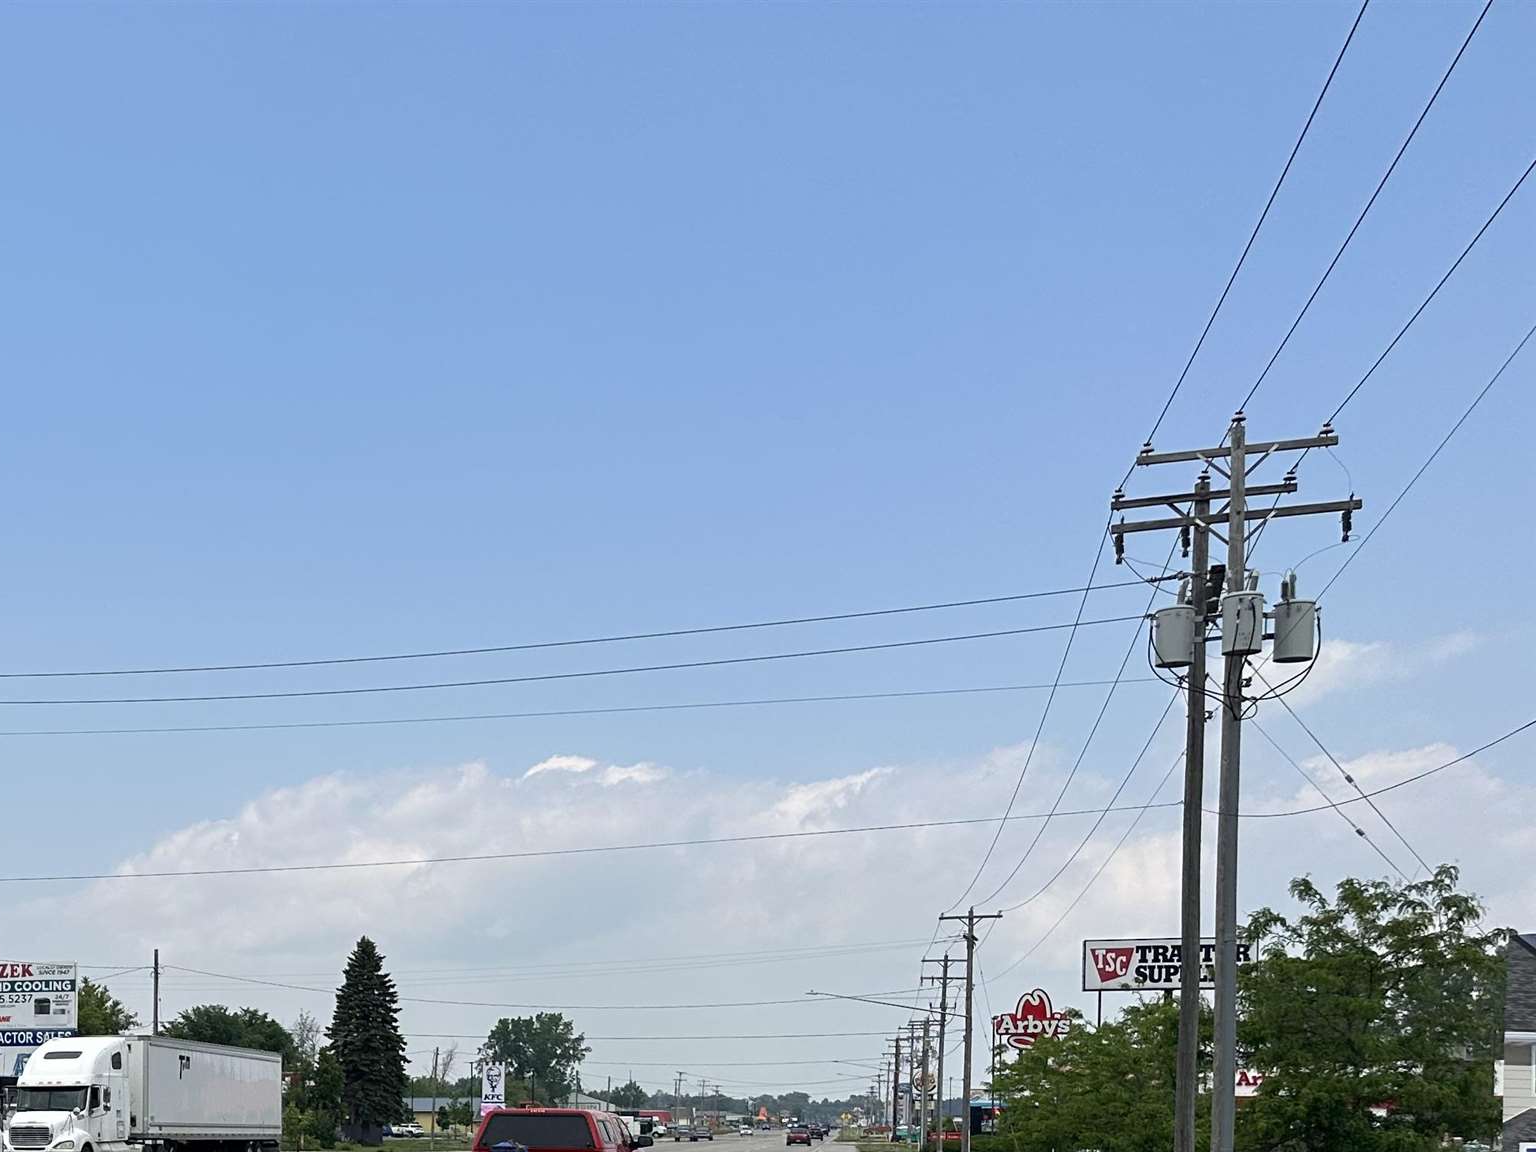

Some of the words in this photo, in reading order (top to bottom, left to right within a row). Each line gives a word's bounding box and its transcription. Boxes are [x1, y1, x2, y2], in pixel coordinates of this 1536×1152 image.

[1094, 949, 1127, 976] TSC
[1135, 944, 1251, 963] TRATR
[1134, 964, 1215, 983] SUPL
[14, 981, 72, 992] COOLING
[997, 1011, 1071, 1037] Arby's
